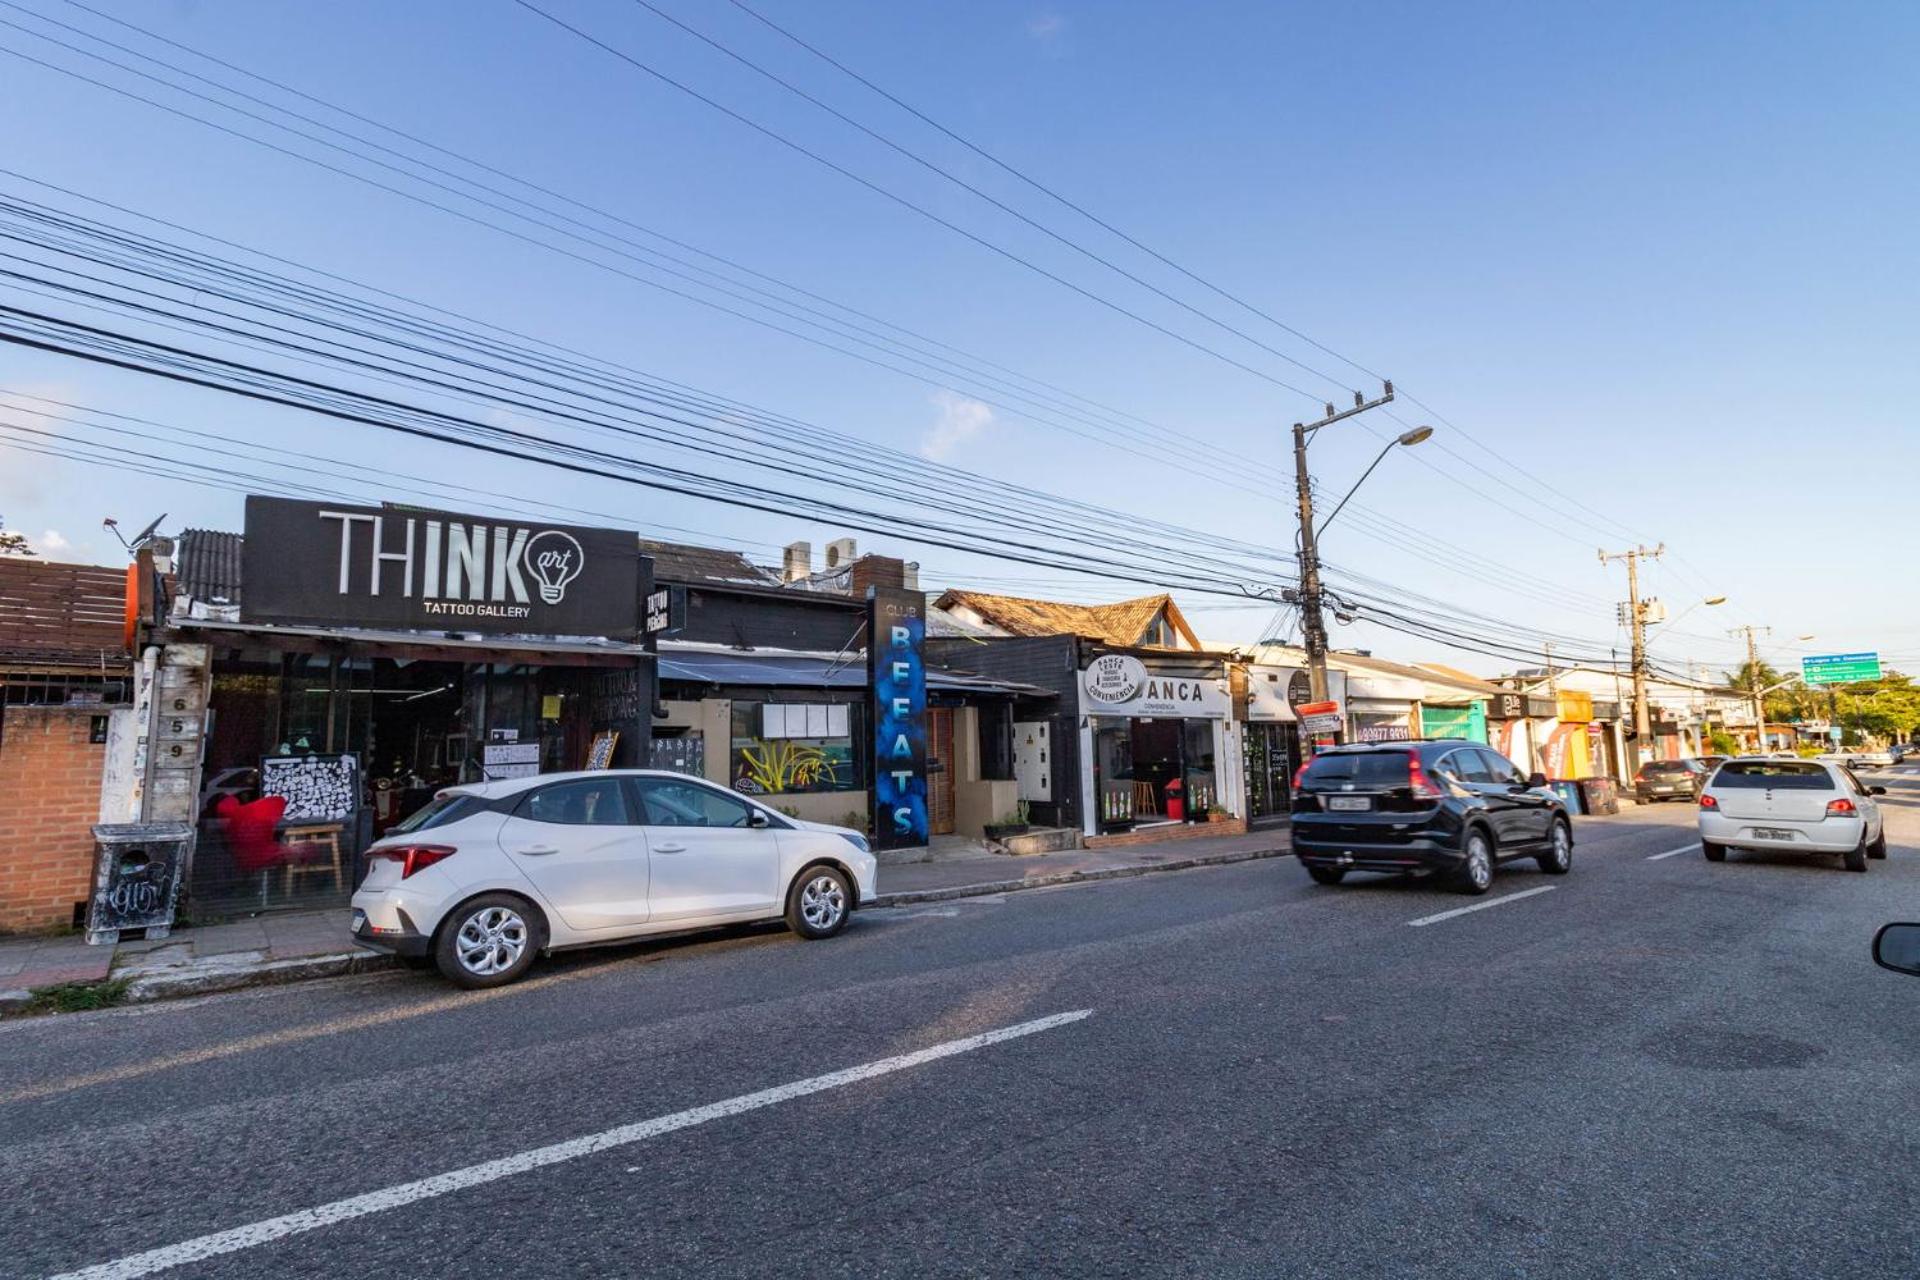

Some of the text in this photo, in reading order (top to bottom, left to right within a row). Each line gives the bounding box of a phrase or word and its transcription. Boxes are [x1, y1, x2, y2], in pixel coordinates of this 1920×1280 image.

[319, 510, 530, 604] THINK
[537, 549, 572, 569] art
[423, 602, 531, 618] TATTOO GALLERY
[886, 604, 917, 618] CLUB
[1138, 681, 1203, 702] ANCA
